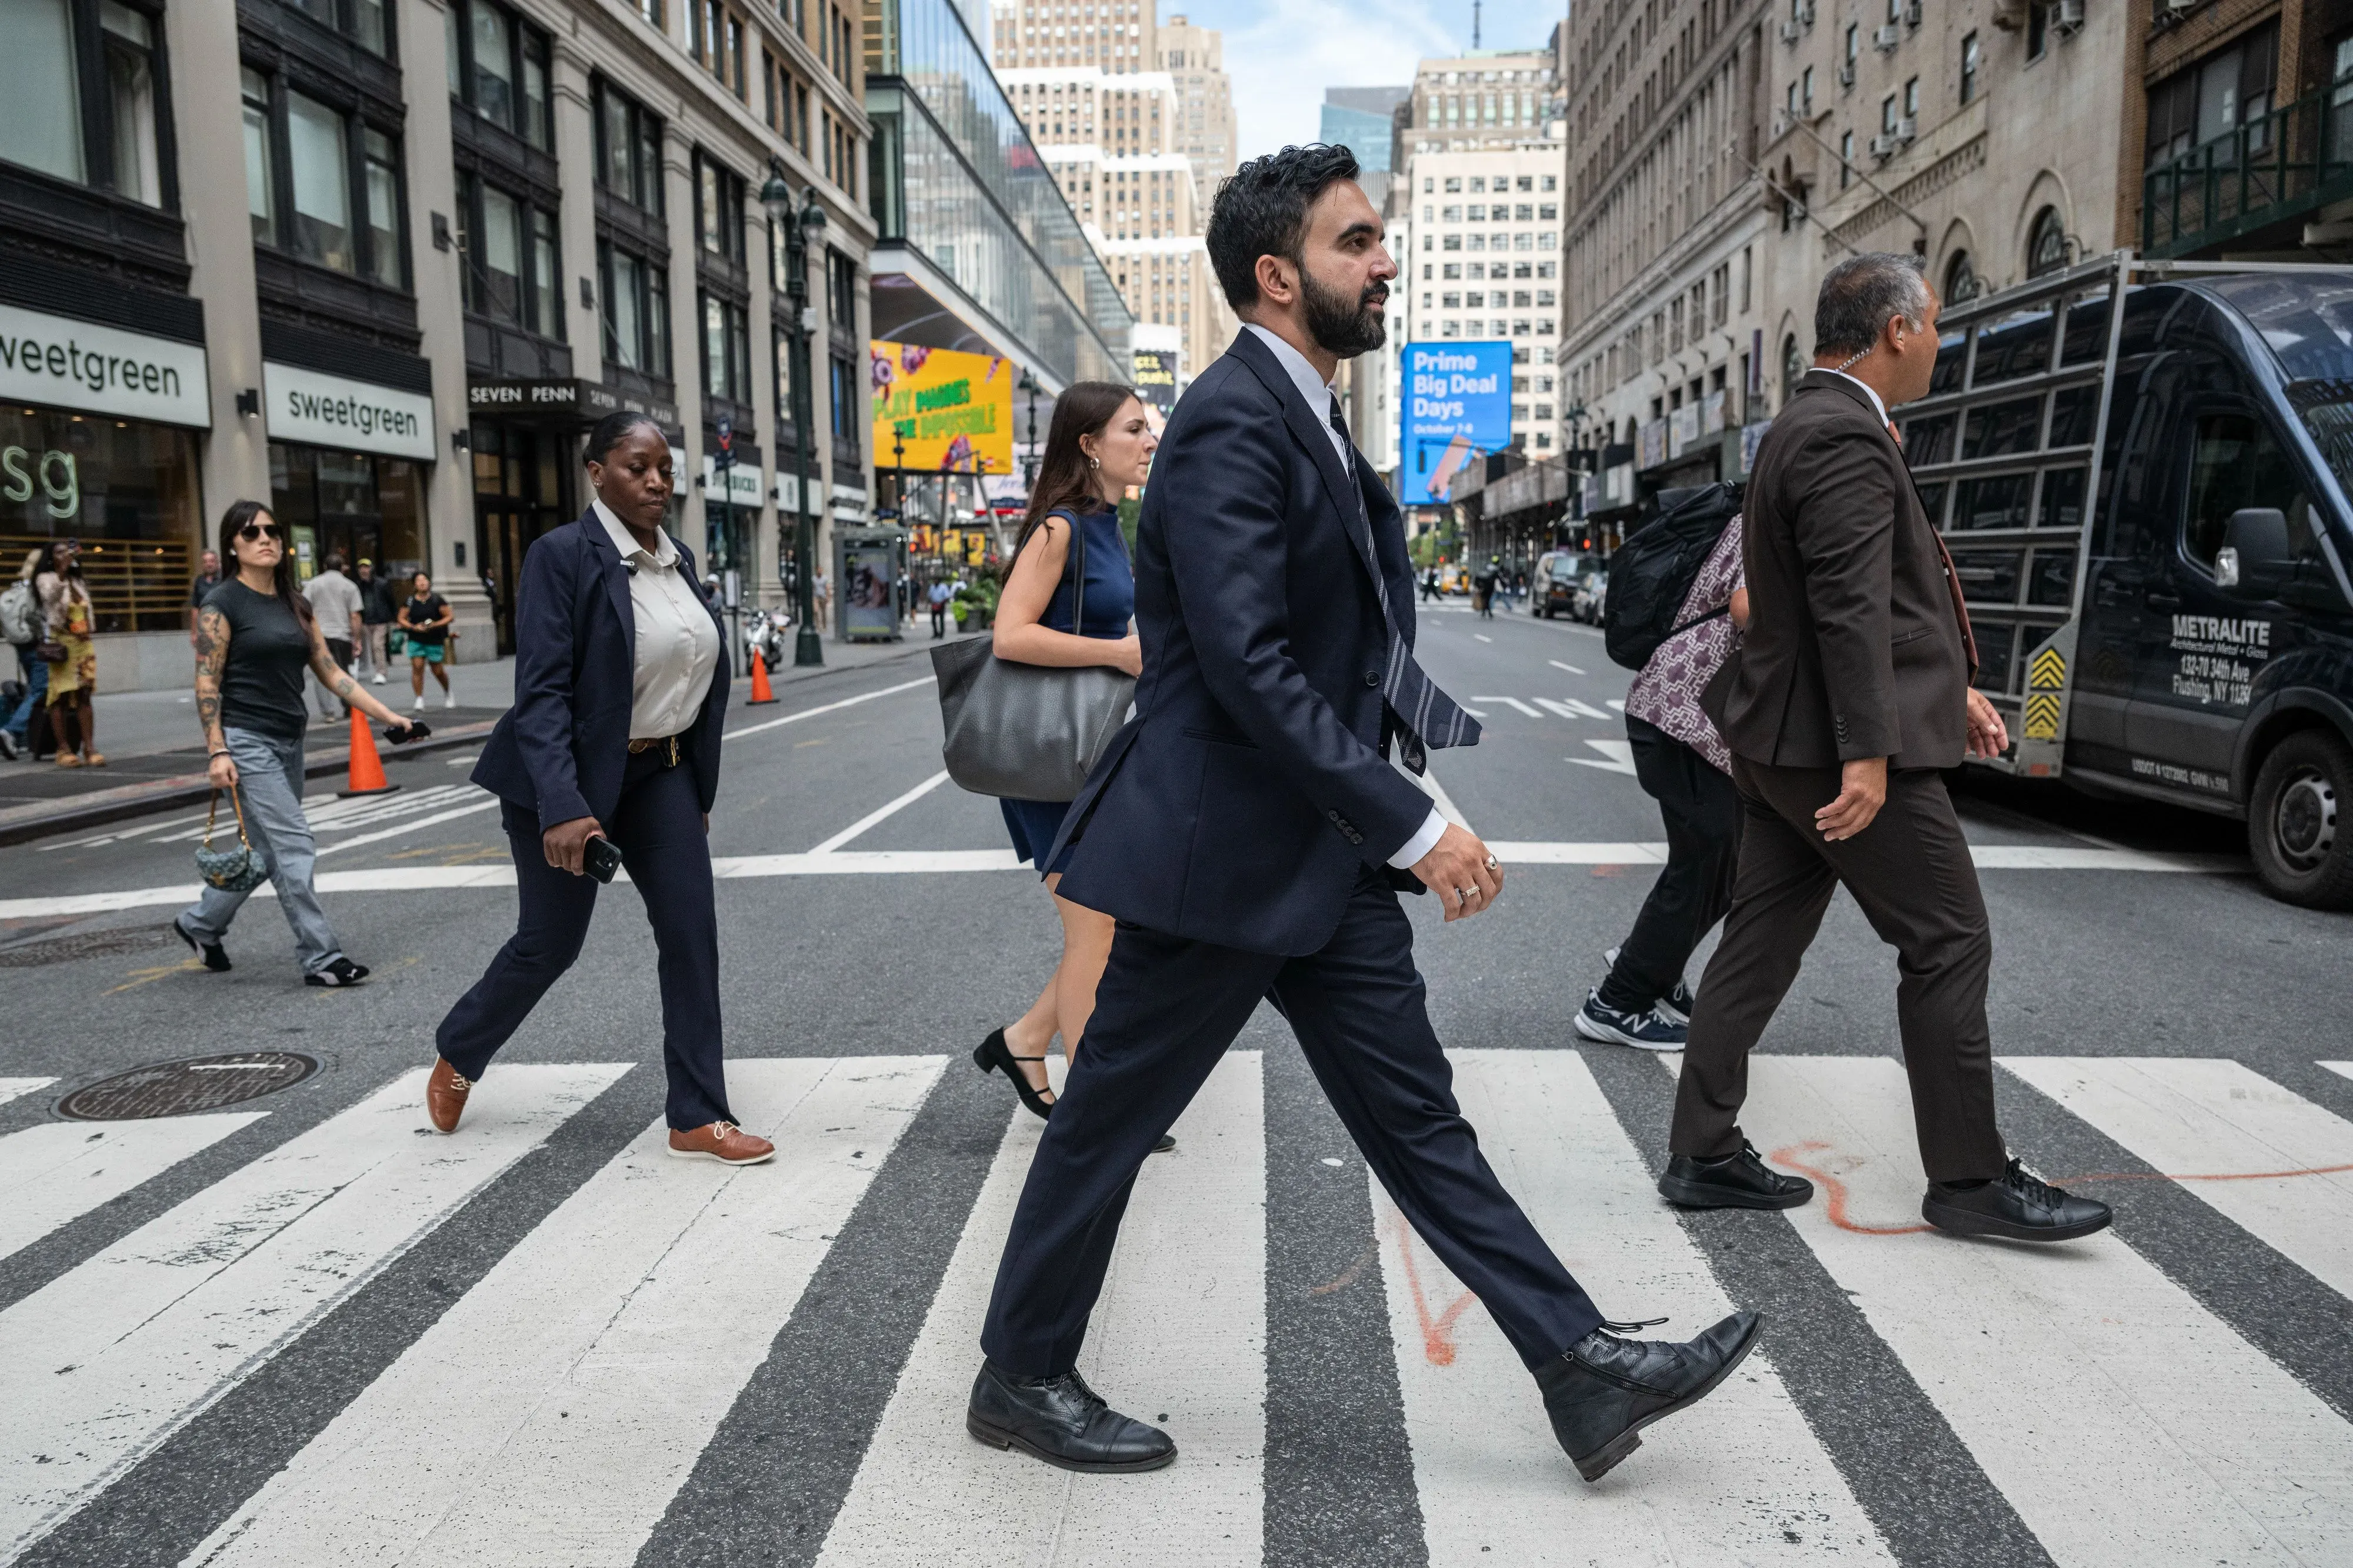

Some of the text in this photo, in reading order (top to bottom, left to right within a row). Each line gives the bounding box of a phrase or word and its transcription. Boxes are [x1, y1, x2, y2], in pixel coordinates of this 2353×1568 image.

[1414, 351, 1478, 371] Prime
[471, 386, 575, 402] SEVEN PENN
[1414, 373, 1498, 399] Big Deal
[289, 389, 418, 438] sweetgreen
[1414, 398, 1464, 421] Days
[3, 445, 79, 518] sg
[2172, 613, 2271, 646] METRALITE
[2216, 642, 2239, 656] Metal
[2246, 645, 2268, 659] Glass
[2231, 660, 2249, 683] Ave
[2213, 680, 2228, 702] NY
[1622, 1013, 1650, 1033] N
